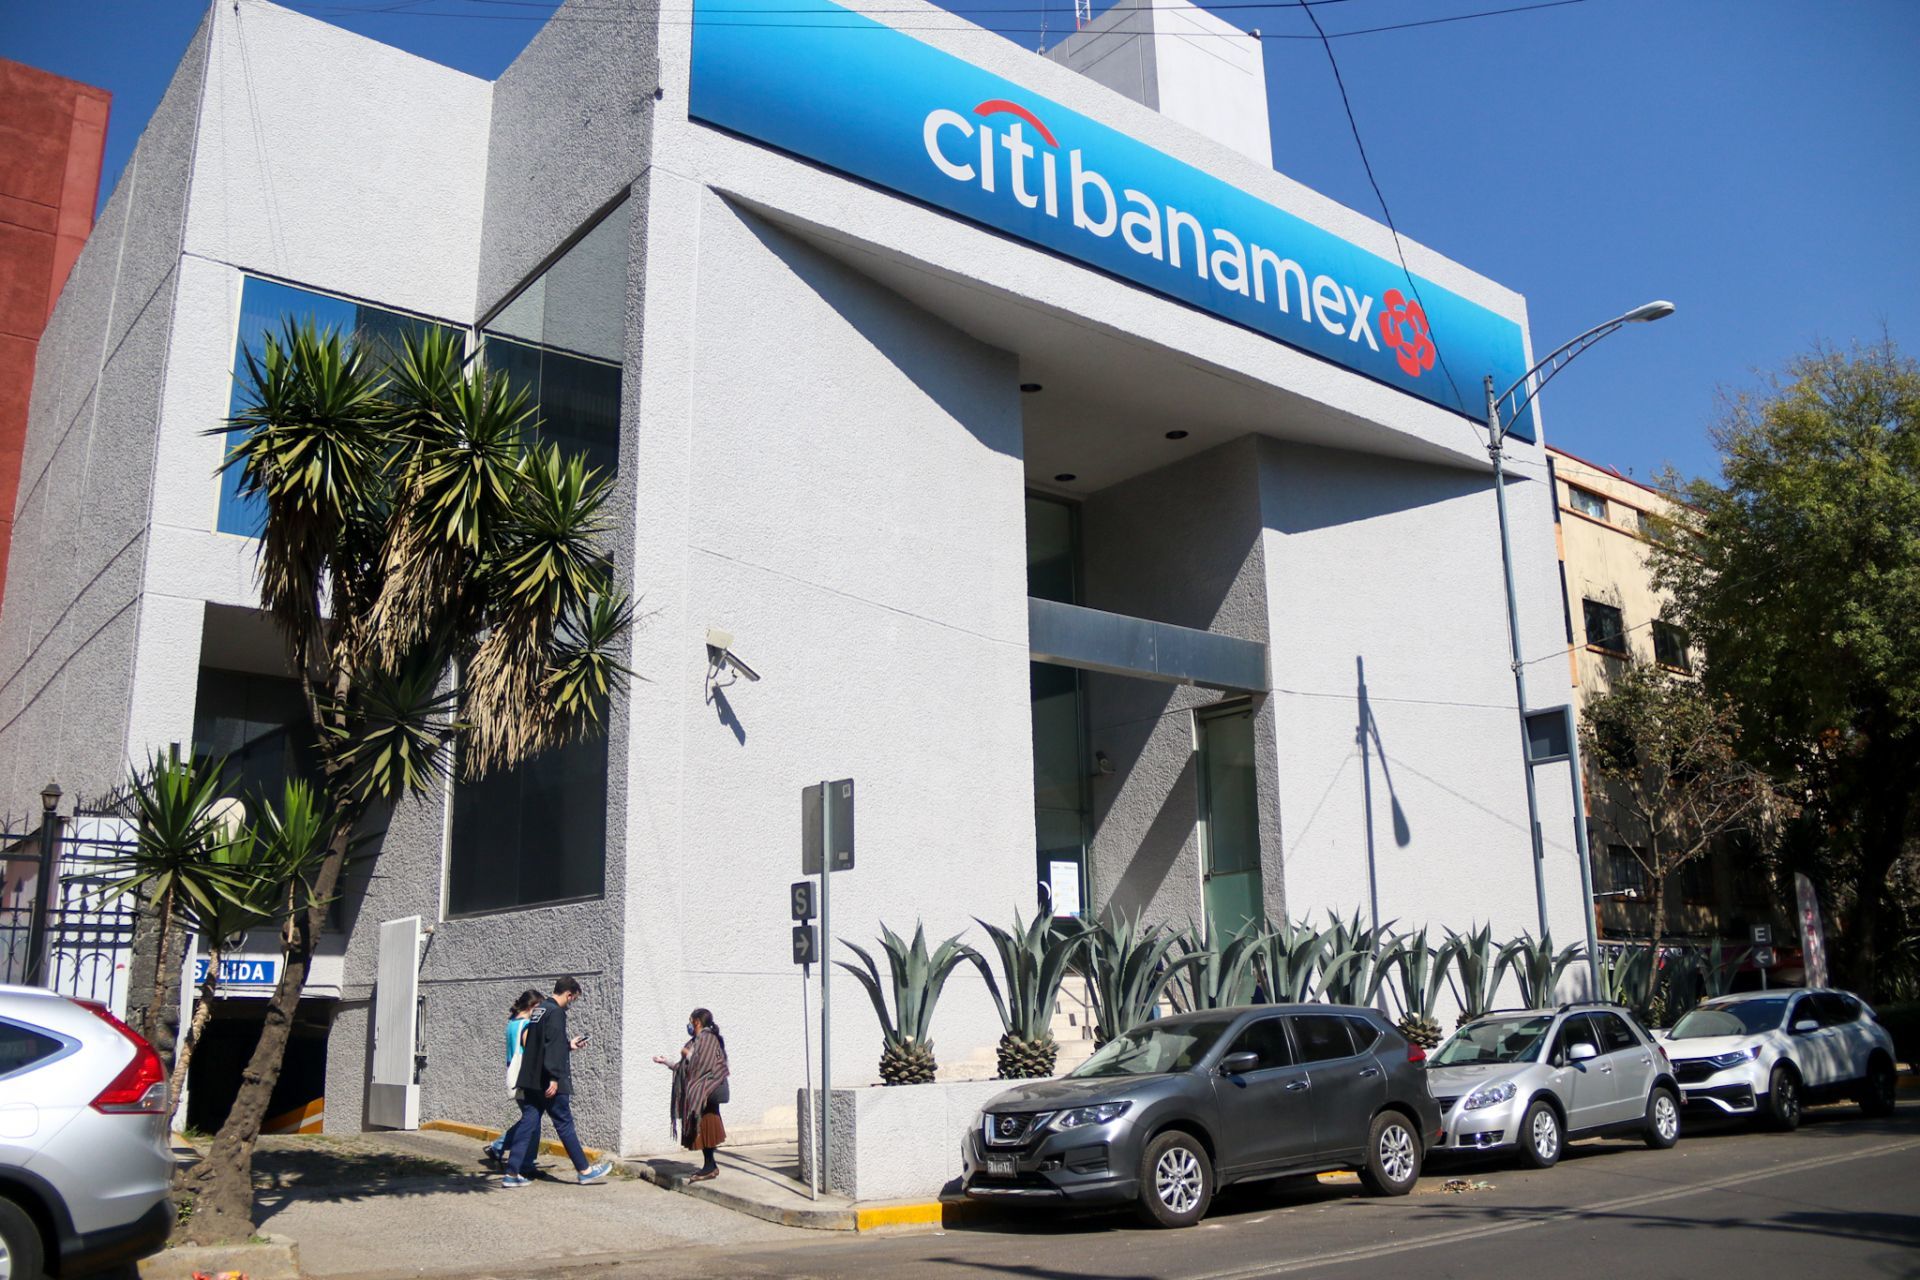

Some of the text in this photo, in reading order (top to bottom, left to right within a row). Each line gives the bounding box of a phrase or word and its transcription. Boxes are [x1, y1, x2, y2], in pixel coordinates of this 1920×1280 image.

[923, 106, 1380, 352] citibanamex
[795, 888, 807, 915] S
[1754, 927, 1766, 942] E
[194, 961, 264, 980] SLIDA
